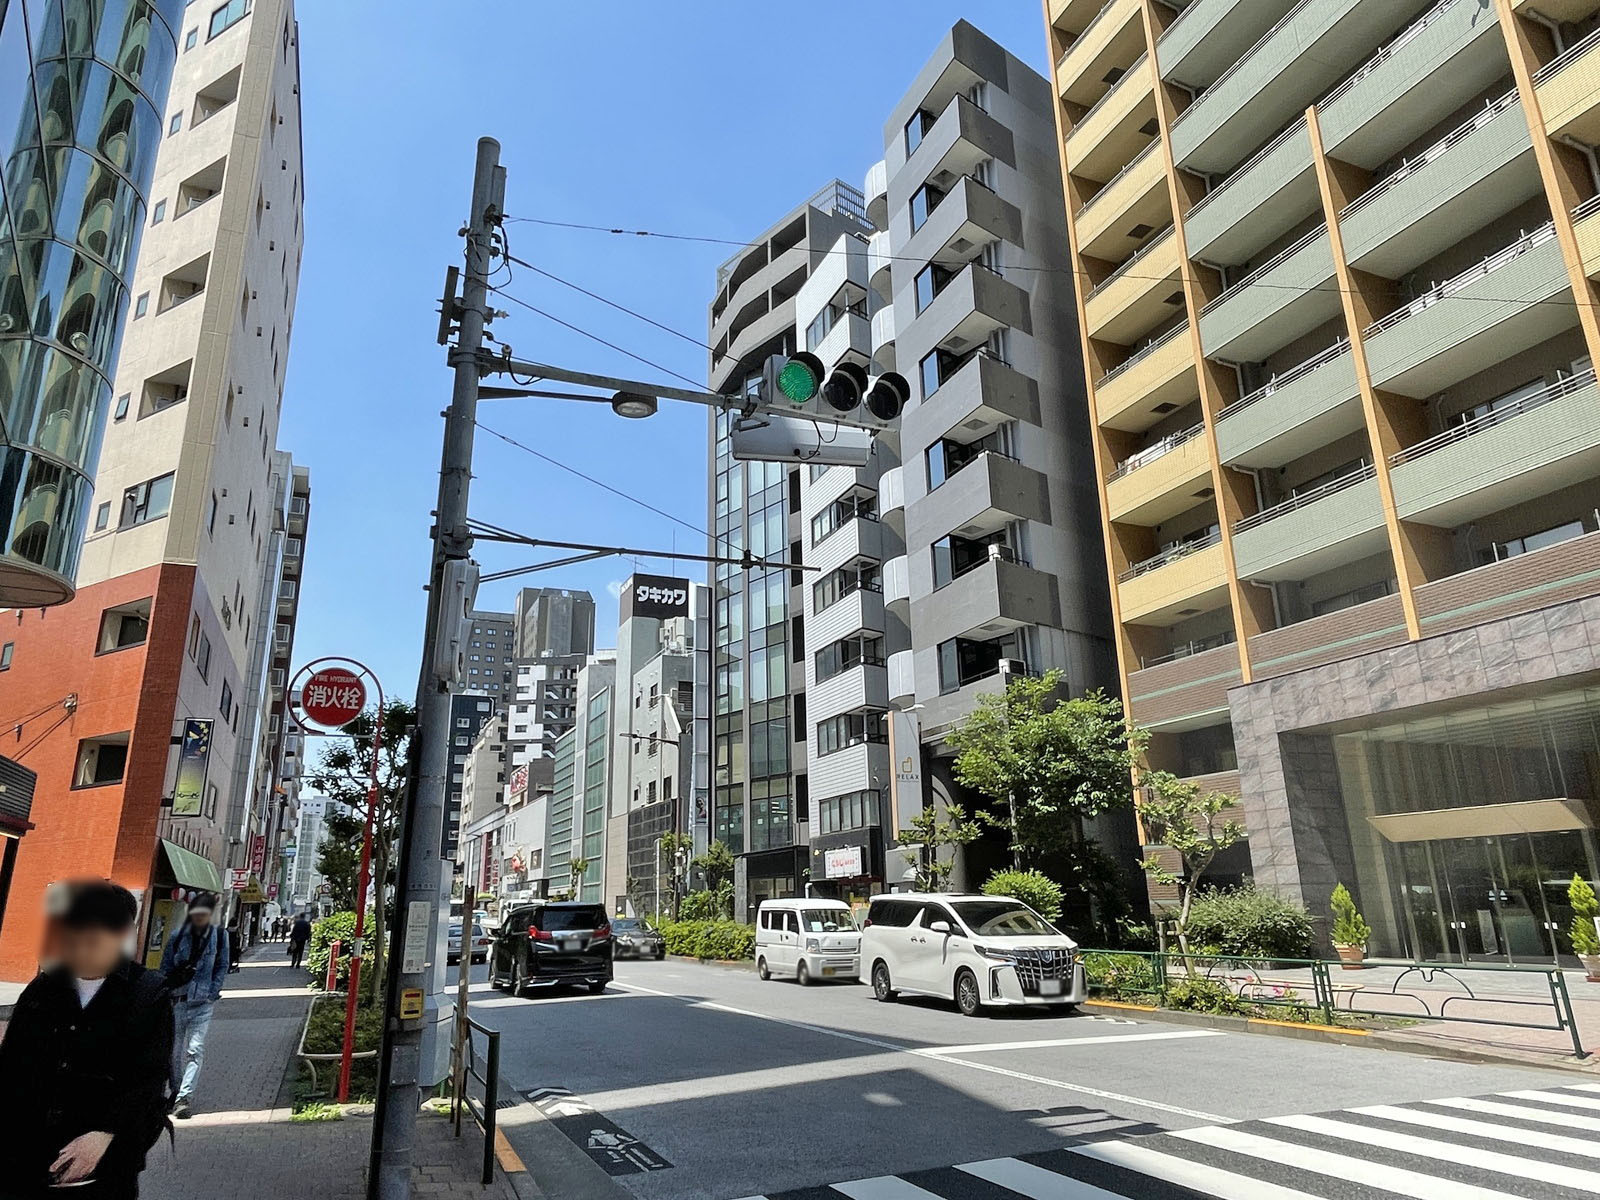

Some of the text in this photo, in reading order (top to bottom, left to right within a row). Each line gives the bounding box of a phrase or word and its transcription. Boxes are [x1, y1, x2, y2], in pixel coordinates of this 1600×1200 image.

[636, 585, 686, 606] タキカワ
[314, 674, 357, 683] FIRE HYDRANT
[307, 684, 361, 710] 消火栓
